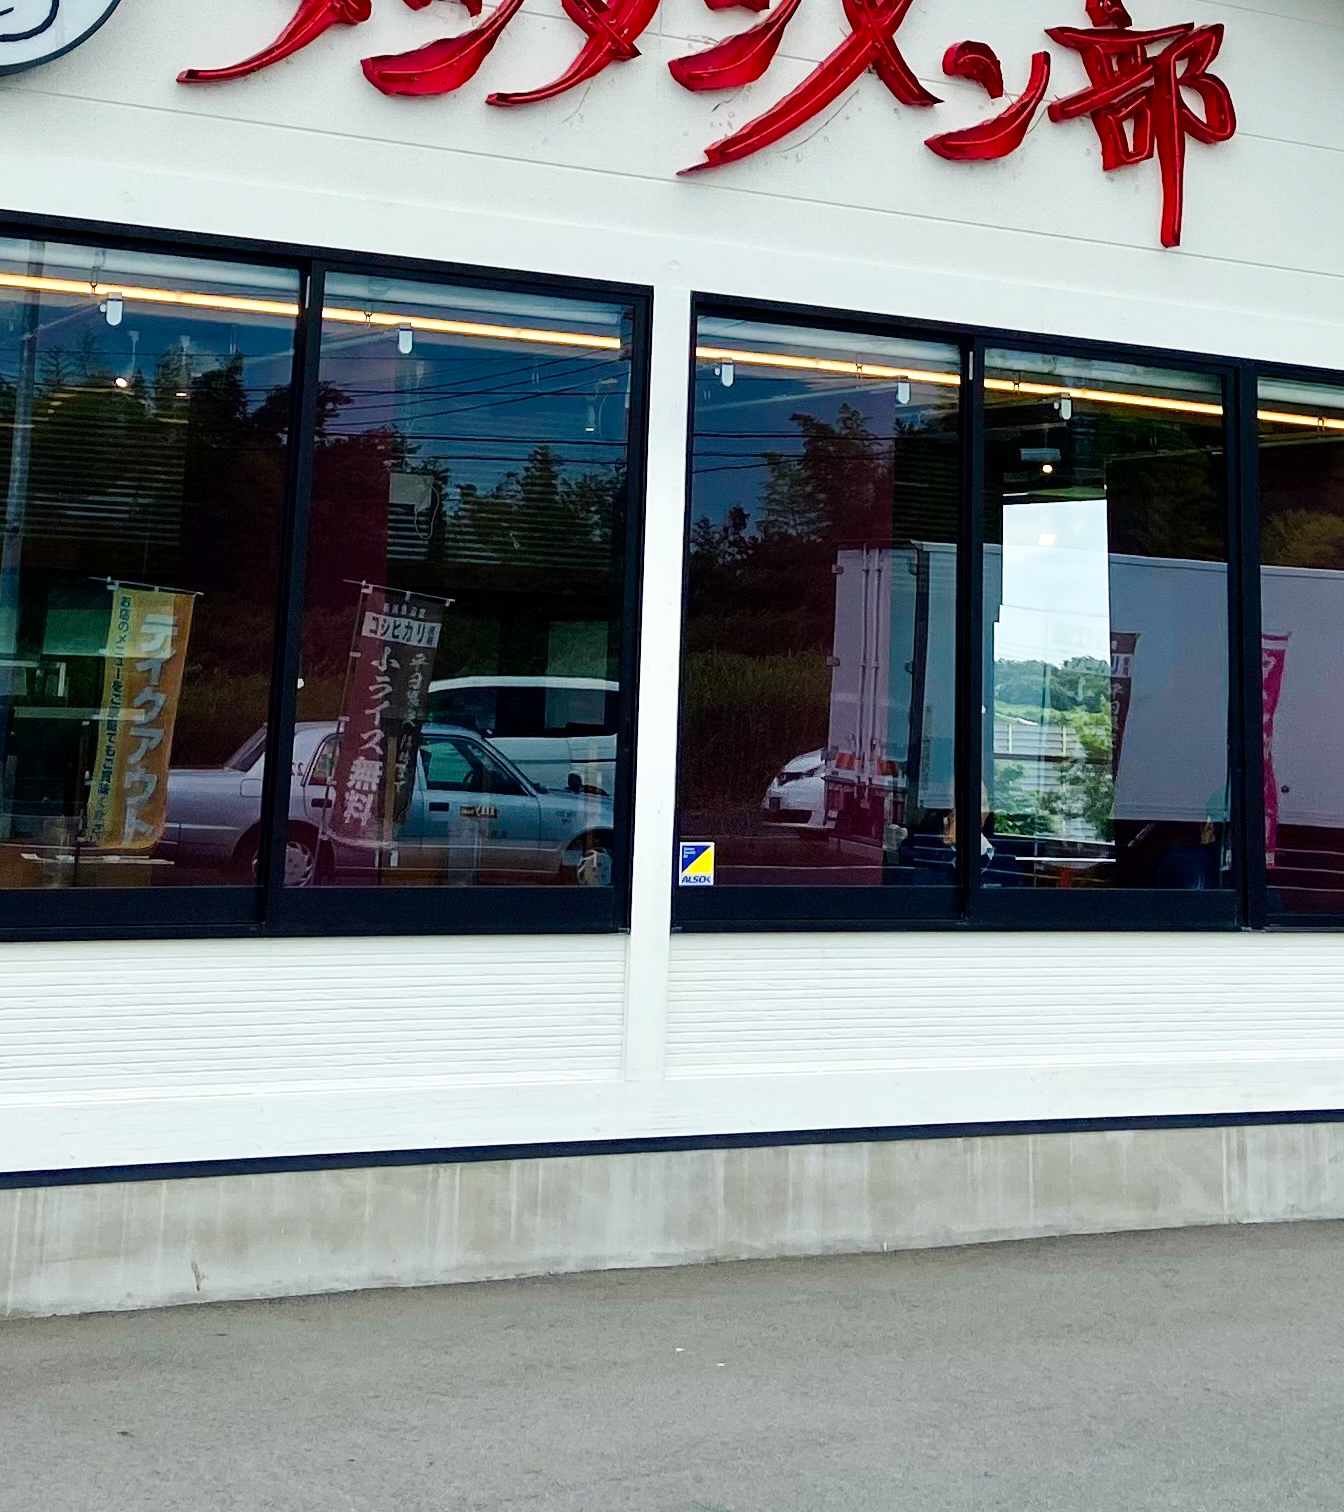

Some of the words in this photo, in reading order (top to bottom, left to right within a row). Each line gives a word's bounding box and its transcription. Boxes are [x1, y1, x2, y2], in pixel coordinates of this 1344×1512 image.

[122, 612, 179, 843] テイクアウト
[343, 646, 400, 827] 小ライス無料
[682, 875, 711, 884] ALSOK
